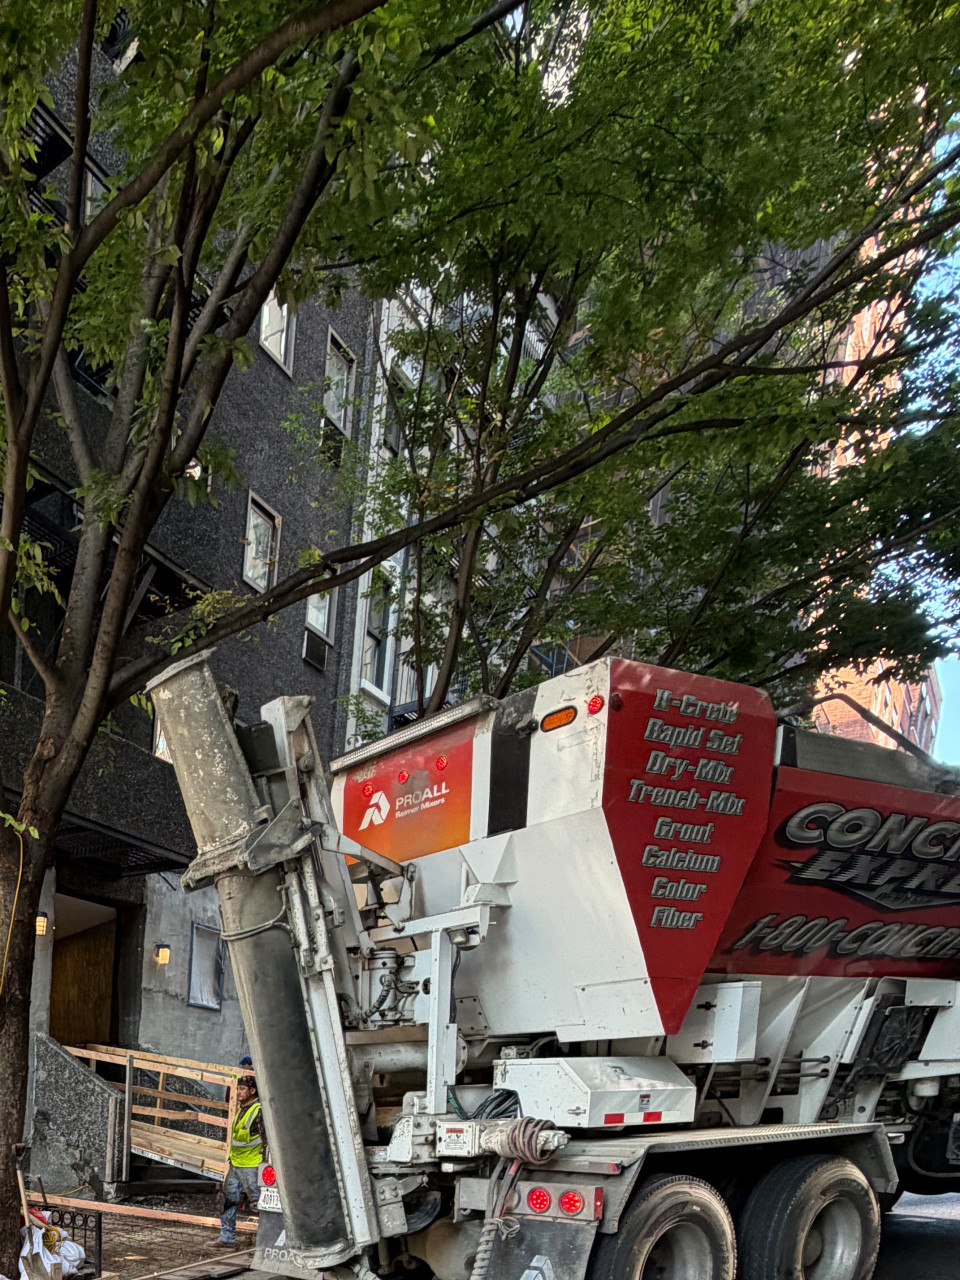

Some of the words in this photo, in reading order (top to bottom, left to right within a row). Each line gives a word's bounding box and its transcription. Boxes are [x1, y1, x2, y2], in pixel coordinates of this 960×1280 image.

[643, 717, 705, 749] Rapid
[706, 729, 742, 756] Set
[646, 751, 734, 785] Dry-Mix
[395, 782, 450, 810] PROALL
[395, 806, 420, 819] Reimer
[420, 798, 446, 811] Mixers
[628, 779, 746, 816] Trench-Mix
[654, 817, 715, 844] Grout
[642, 845, 721, 873] Calcium
[651, 877, 708, 901] Color
[650, 906, 704, 929] Fiber
[264, 1247, 295, 1261] PROA
